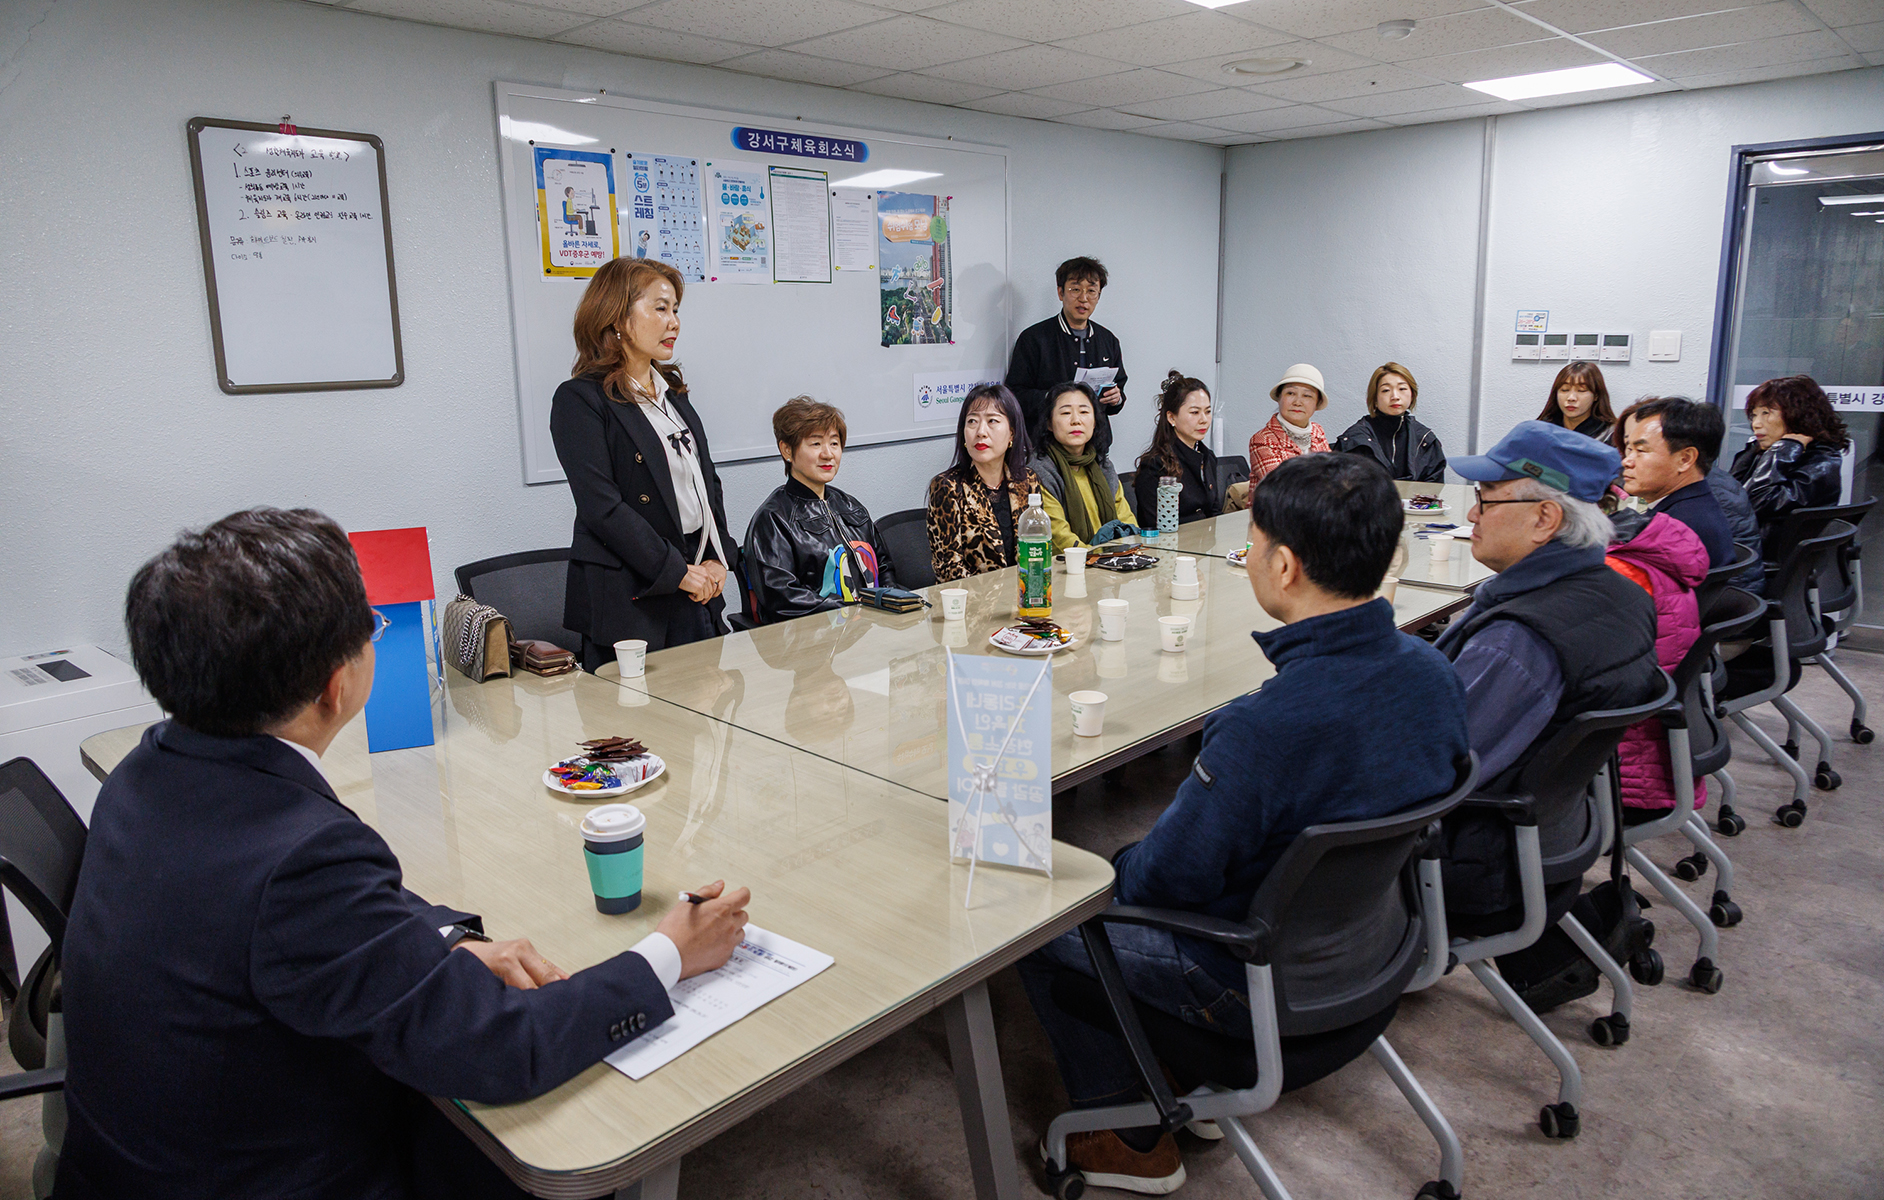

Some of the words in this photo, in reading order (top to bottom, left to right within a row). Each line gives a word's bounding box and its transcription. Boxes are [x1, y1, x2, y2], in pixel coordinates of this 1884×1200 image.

[747, 132, 855, 159] 강서구체육회소식
[562, 239, 581, 249] 올바른
[559, 250, 590, 259] VDT증후군
[590, 250, 605, 259] 예방!
[936, 383, 966, 395] 서울특별시
[936, 396, 949, 405] Seoul
